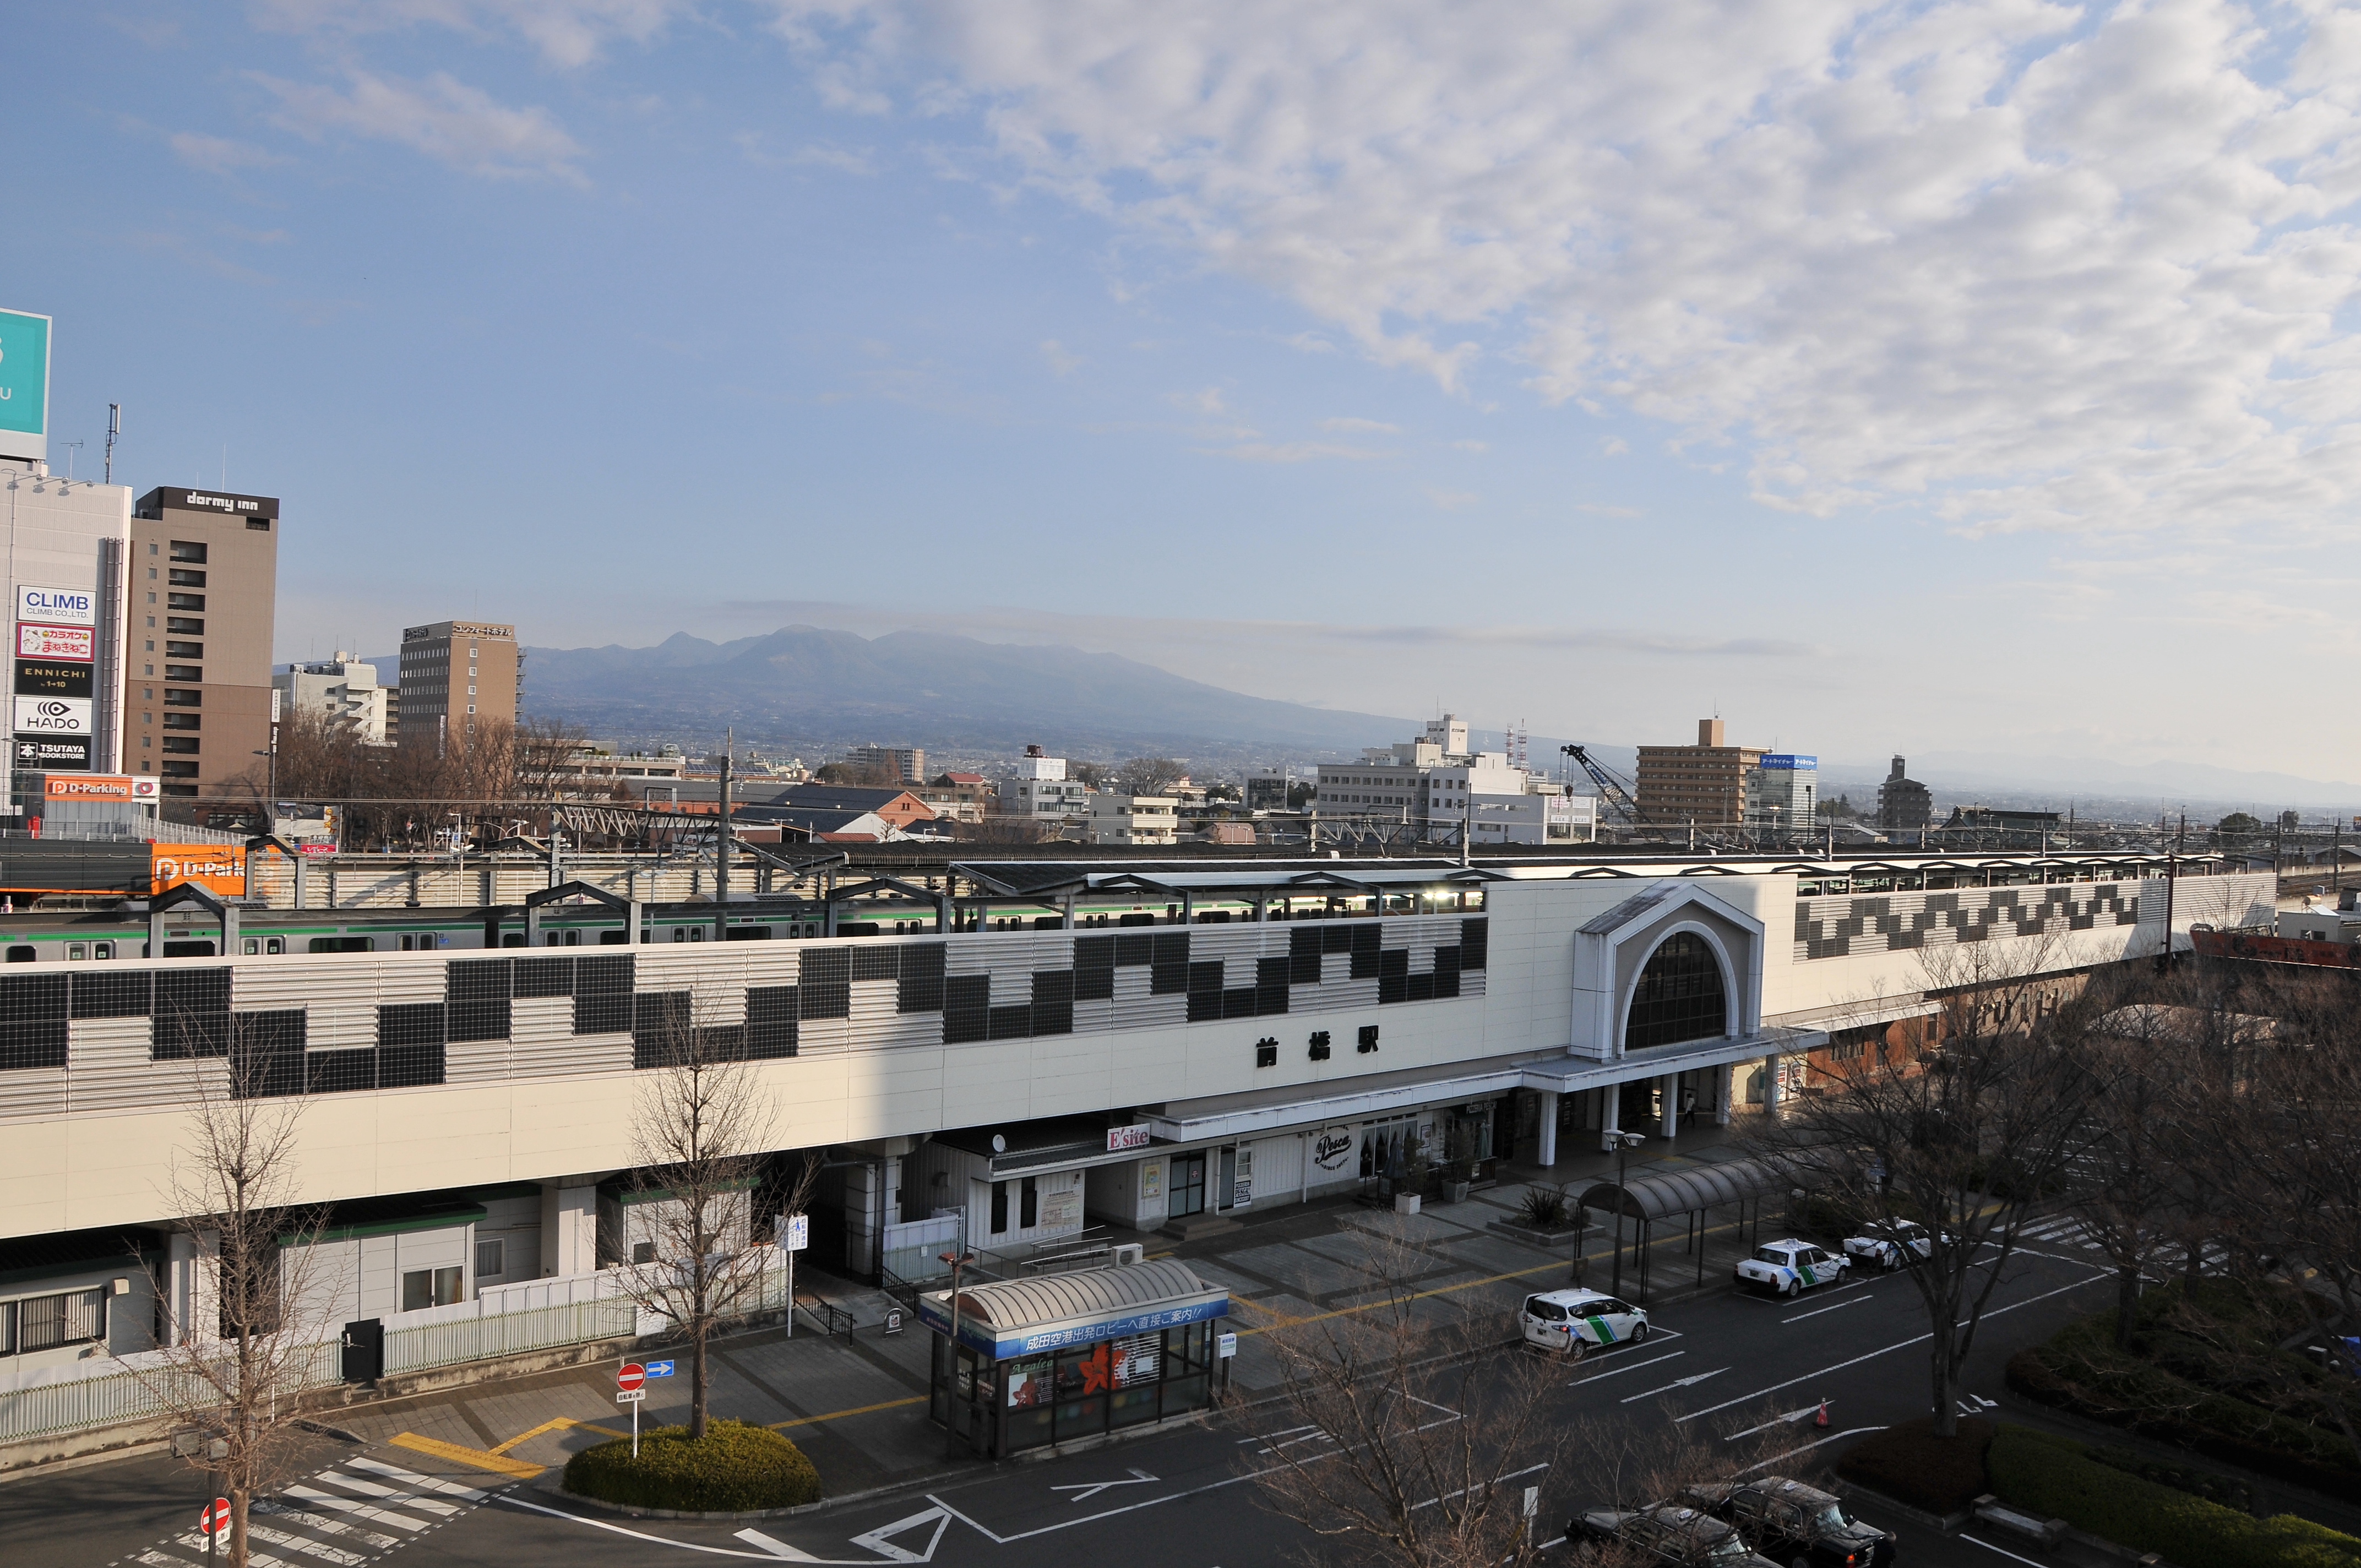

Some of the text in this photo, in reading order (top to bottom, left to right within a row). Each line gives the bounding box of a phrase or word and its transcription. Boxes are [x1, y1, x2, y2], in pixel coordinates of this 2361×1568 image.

[187, 491, 258, 512] dormy inn
[26, 592, 89, 610] CLIMB
[50, 630, 82, 639] カラオケ
[456, 625, 512, 636] コンフォートホテル
[43, 641, 88, 654] まねきねこ
[25, 668, 85, 678] ENNICHI
[28, 717, 79, 729] HADO
[20, 744, 35, 757] 本
[40, 744, 85, 753] TSUTAYA
[322, 808, 338, 834] カラオケ
[1315, 1134, 1352, 1164] Pesca
[1026, 1308, 1202, 1351] 成田空港出発ロビーへ直接ご案内!!
[1012, 1358, 1053, 1374] Azalea
